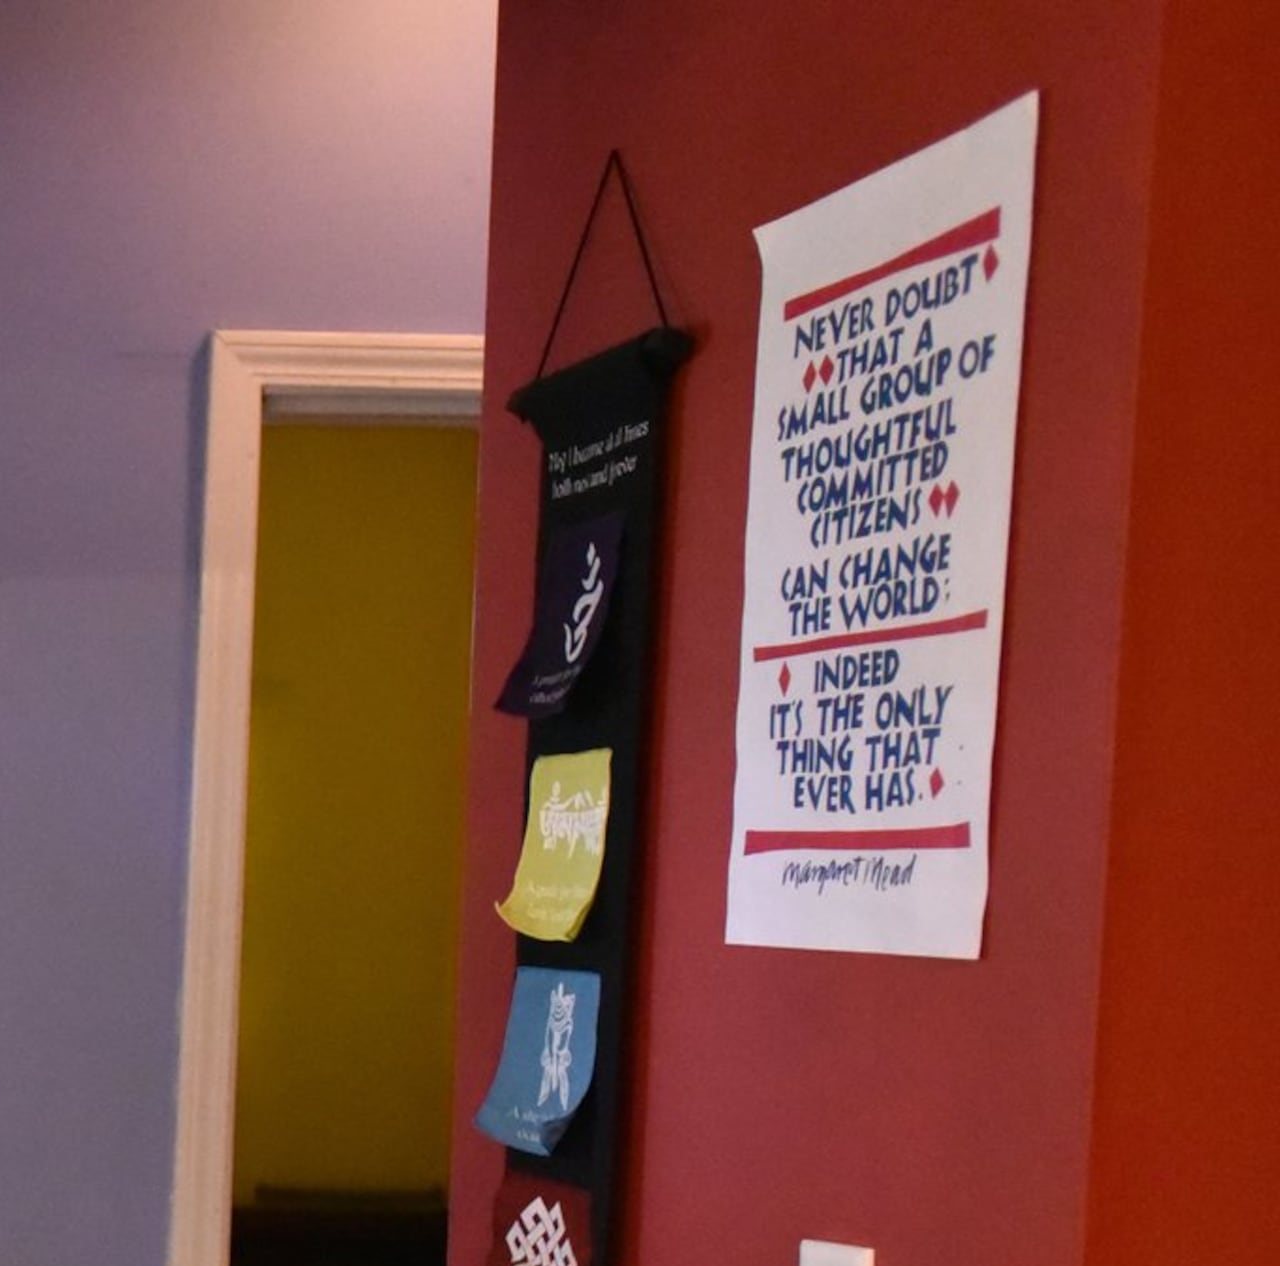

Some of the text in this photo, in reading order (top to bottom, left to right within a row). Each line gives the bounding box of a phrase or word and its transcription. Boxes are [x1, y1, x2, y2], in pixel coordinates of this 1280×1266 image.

[794, 253, 978, 358] NEVER DOUBT
[837, 318, 934, 384] THAT A
[777, 335, 996, 442] SMALL GROUP OF
[781, 398, 957, 483] THOUGHTFUL
[797, 441, 948, 515] COMMITTED
[810, 489, 921, 549] CITIZENS
[781, 533, 951, 602] CAN CHANGE
[789, 597, 832, 637] THE
[814, 648, 900, 693] INDEED
[769, 685, 953, 740] IT'S THE ONLY
[776, 727, 941, 775] THING THAT
[793, 768, 924, 815] EVER HAS.
